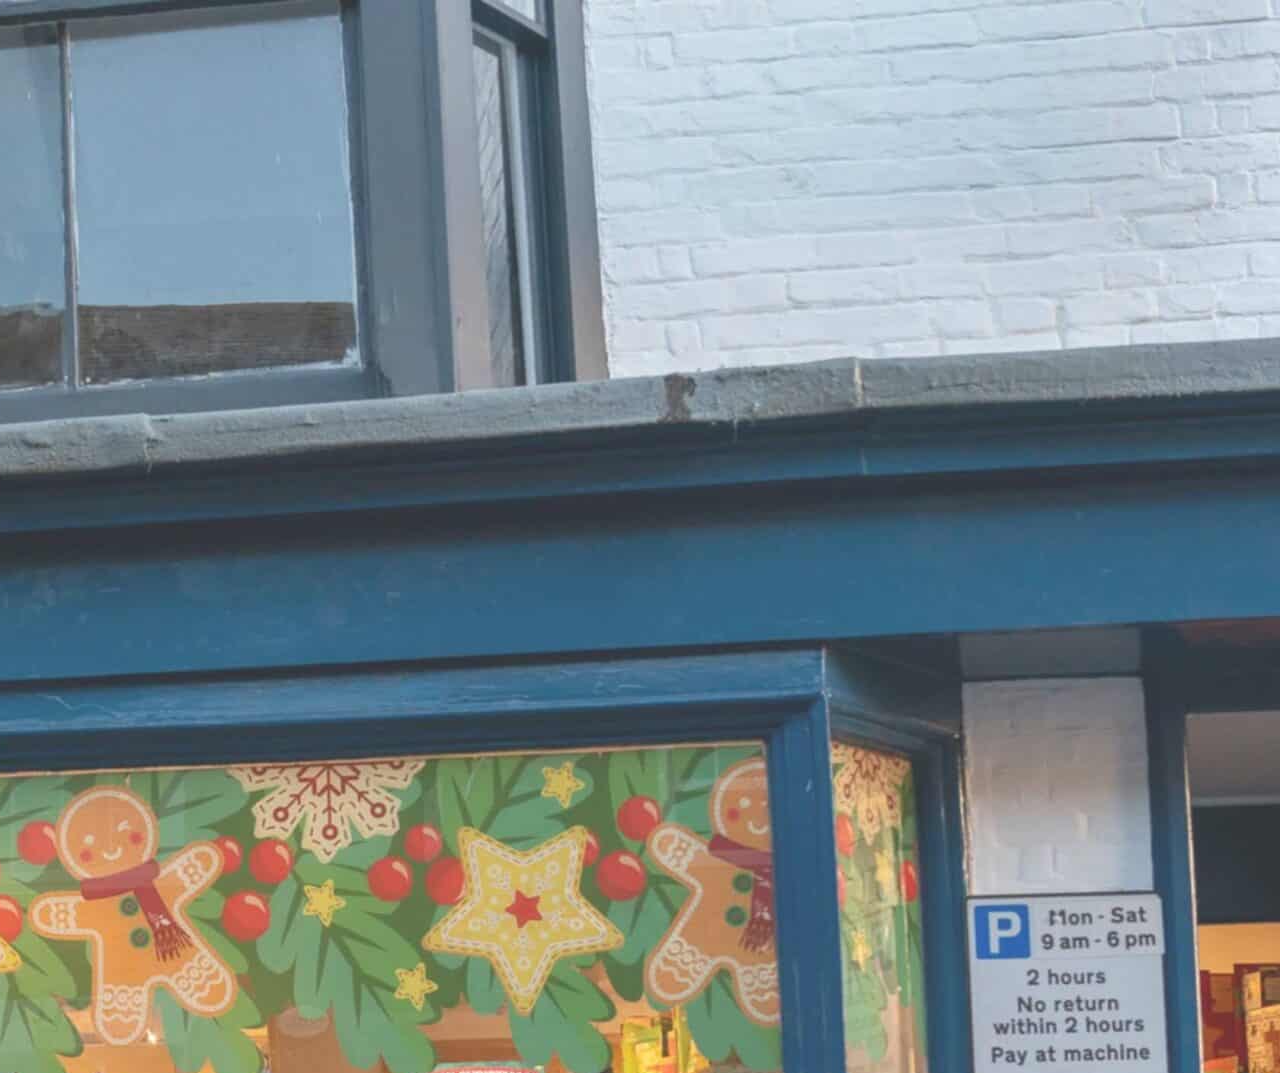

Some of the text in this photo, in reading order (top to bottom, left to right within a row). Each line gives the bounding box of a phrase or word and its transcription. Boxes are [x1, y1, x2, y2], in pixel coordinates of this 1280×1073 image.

[1049, 909, 1093, 926] Mon
[1111, 907, 1148, 924] Sat
[988, 911, 1021, 954] P
[1041, 934, 1055, 951] 9
[1060, 937, 1090, 950] am
[1107, 931, 1120, 948] 6
[1124, 933, 1157, 953] pm
[1026, 969, 1107, 986] 2 hours
[1017, 995, 1120, 1012] No return
[993, 1016, 1145, 1036] within 2 hours
[991, 1045, 1151, 1066] Pay at machine
